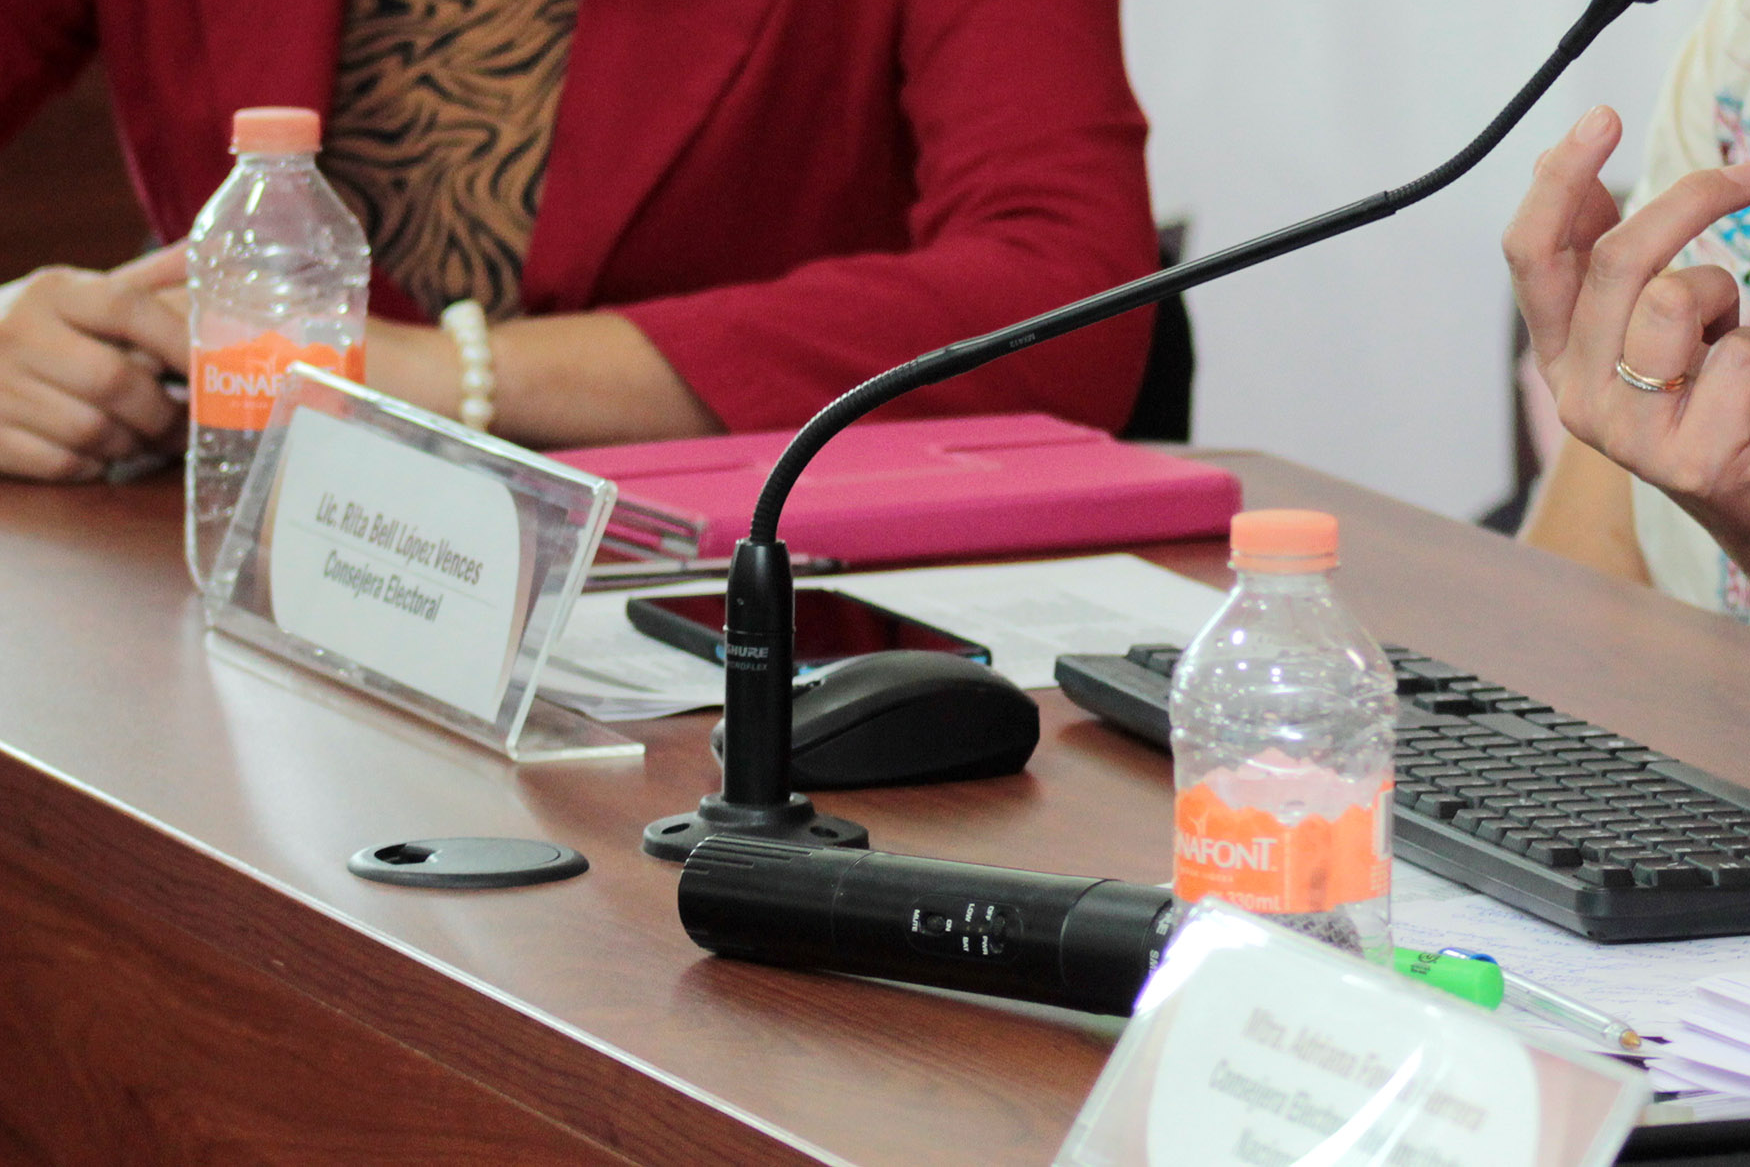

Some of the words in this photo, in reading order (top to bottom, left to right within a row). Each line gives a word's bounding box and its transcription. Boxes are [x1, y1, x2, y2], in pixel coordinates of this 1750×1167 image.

[340, 501, 369, 538] Rita
[368, 512, 400, 550] Bell
[395, 524, 436, 566] López
[434, 538, 484, 585] Vences
[323, 549, 385, 599] Consejera
[383, 574, 444, 622] Electoral
[1175, 834, 1278, 872] NAFONT
[911, 908, 920, 933] MUTE
[1208, 1058, 1288, 1114] Consejera
